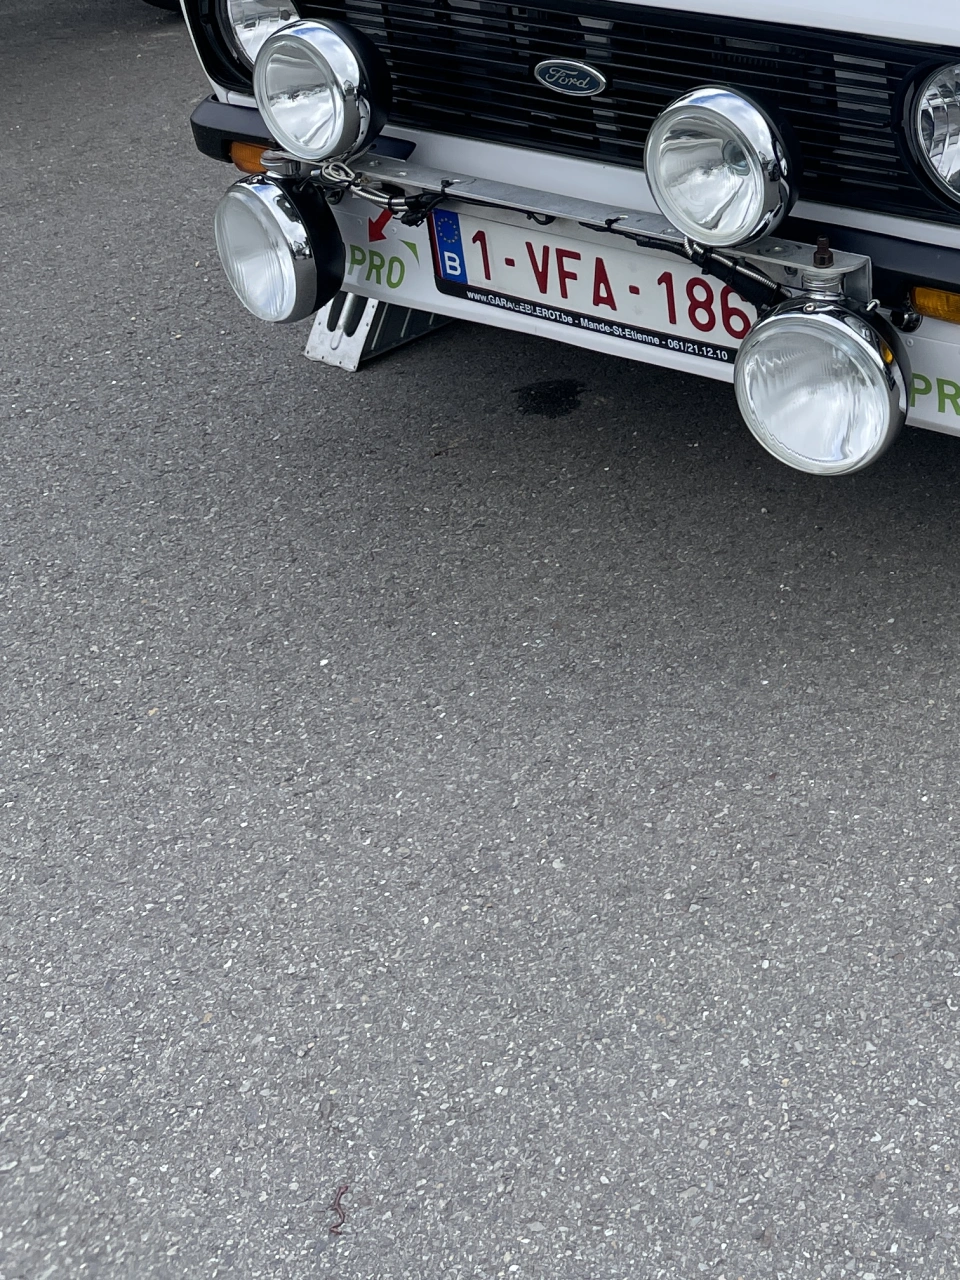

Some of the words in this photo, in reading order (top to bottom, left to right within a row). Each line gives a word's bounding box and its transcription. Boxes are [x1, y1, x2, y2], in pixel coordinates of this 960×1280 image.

[545, 67, 590, 89] Ford
[350, 244, 406, 289] PRO
[444, 251, 462, 277] B
[471, 230, 752, 340] 1-VFA-186
[580, 317, 660, 345] Mande-St-Etienne
[667, 339, 729, 361] 061/21.12.10
